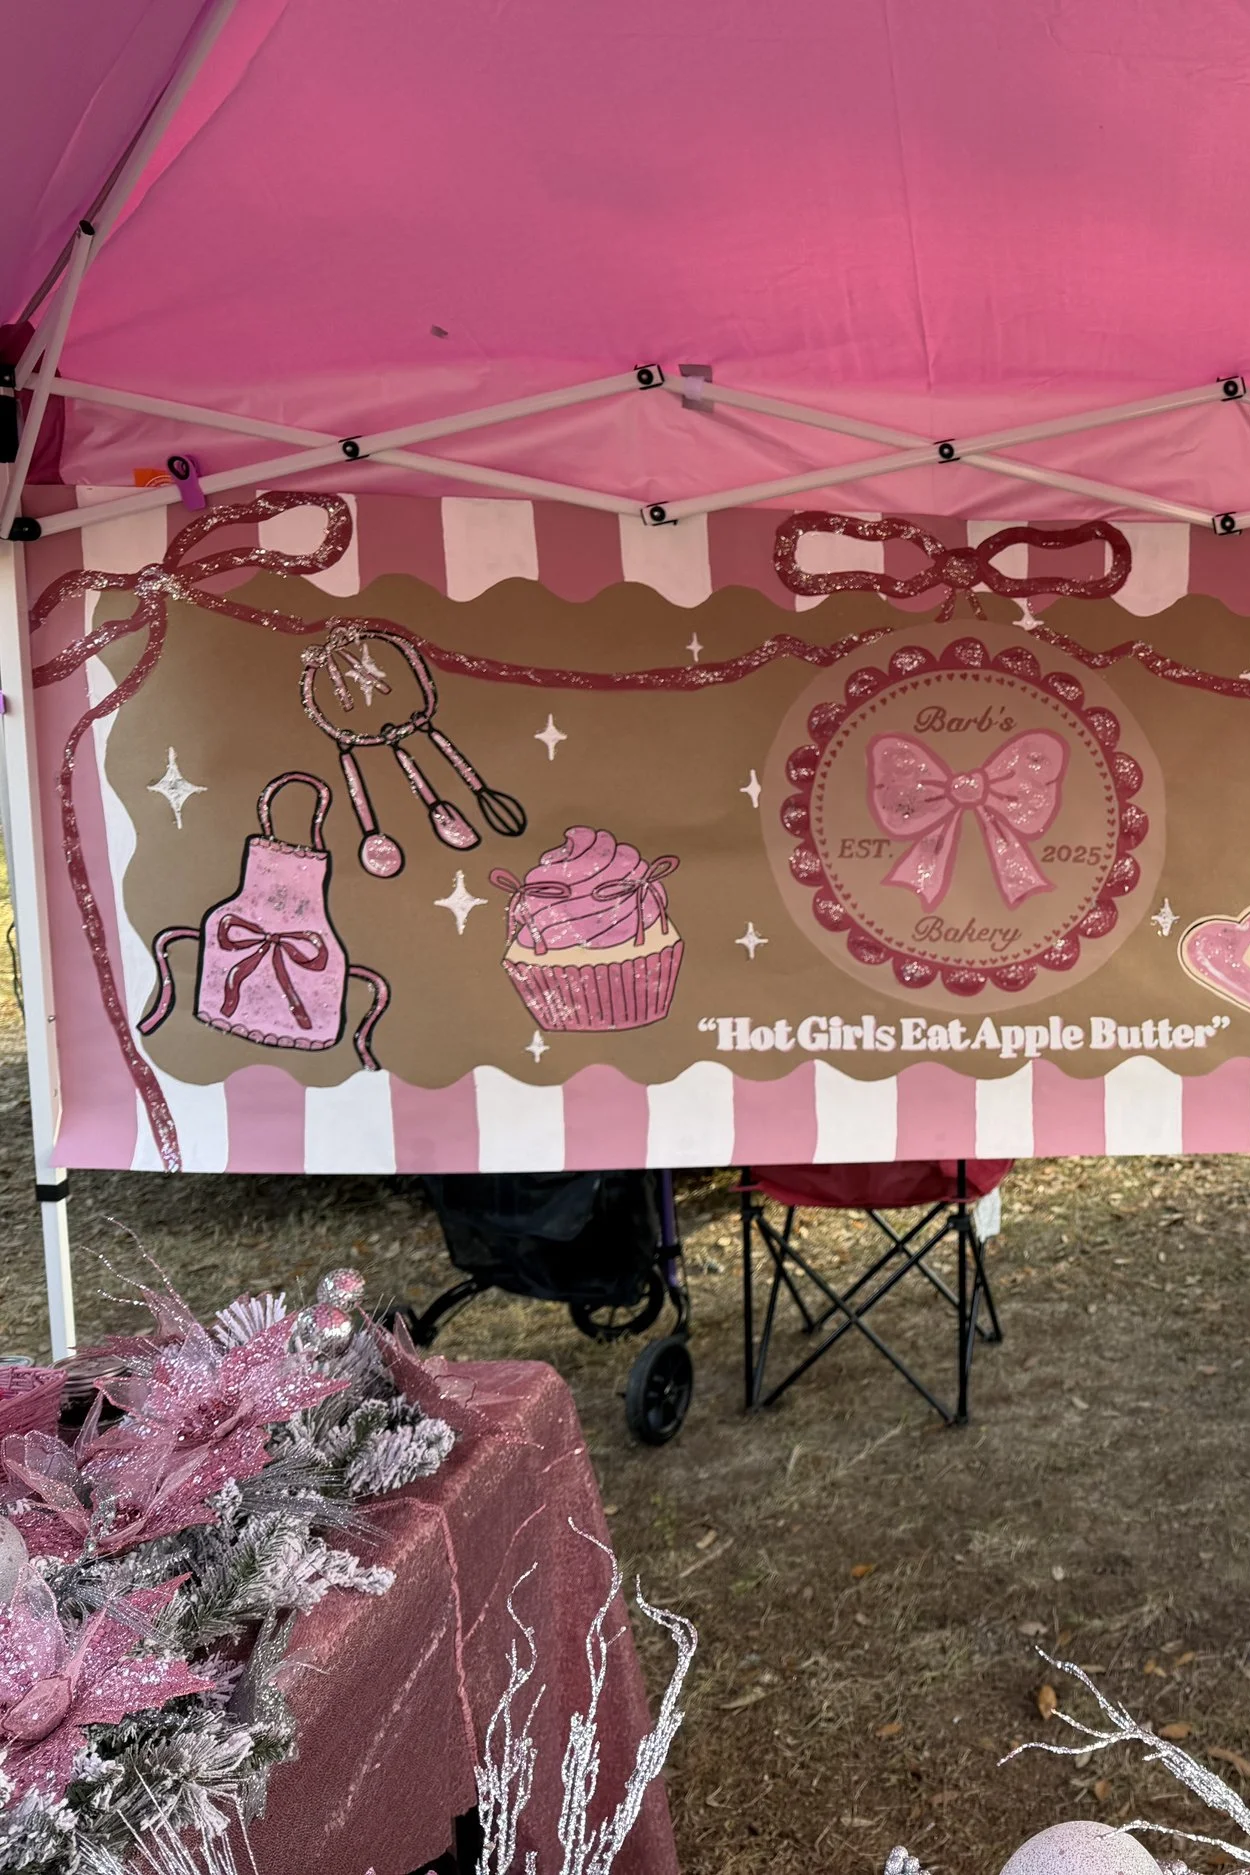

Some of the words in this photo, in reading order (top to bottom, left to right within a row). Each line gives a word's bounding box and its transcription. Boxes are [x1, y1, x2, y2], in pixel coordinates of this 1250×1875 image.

[914, 706, 1017, 733] Barb's
[838, 838, 895, 860] EST.
[1041, 846, 1101, 866] 2025
[911, 916, 1023, 952] Bakery
[697, 1016, 794, 1051] “Hot
[797, 1016, 896, 1052] Girls
[900, 1017, 970, 1051] Eat
[971, 1016, 1083, 1059] Apple
[1090, 1016, 1231, 1051] Butter”
